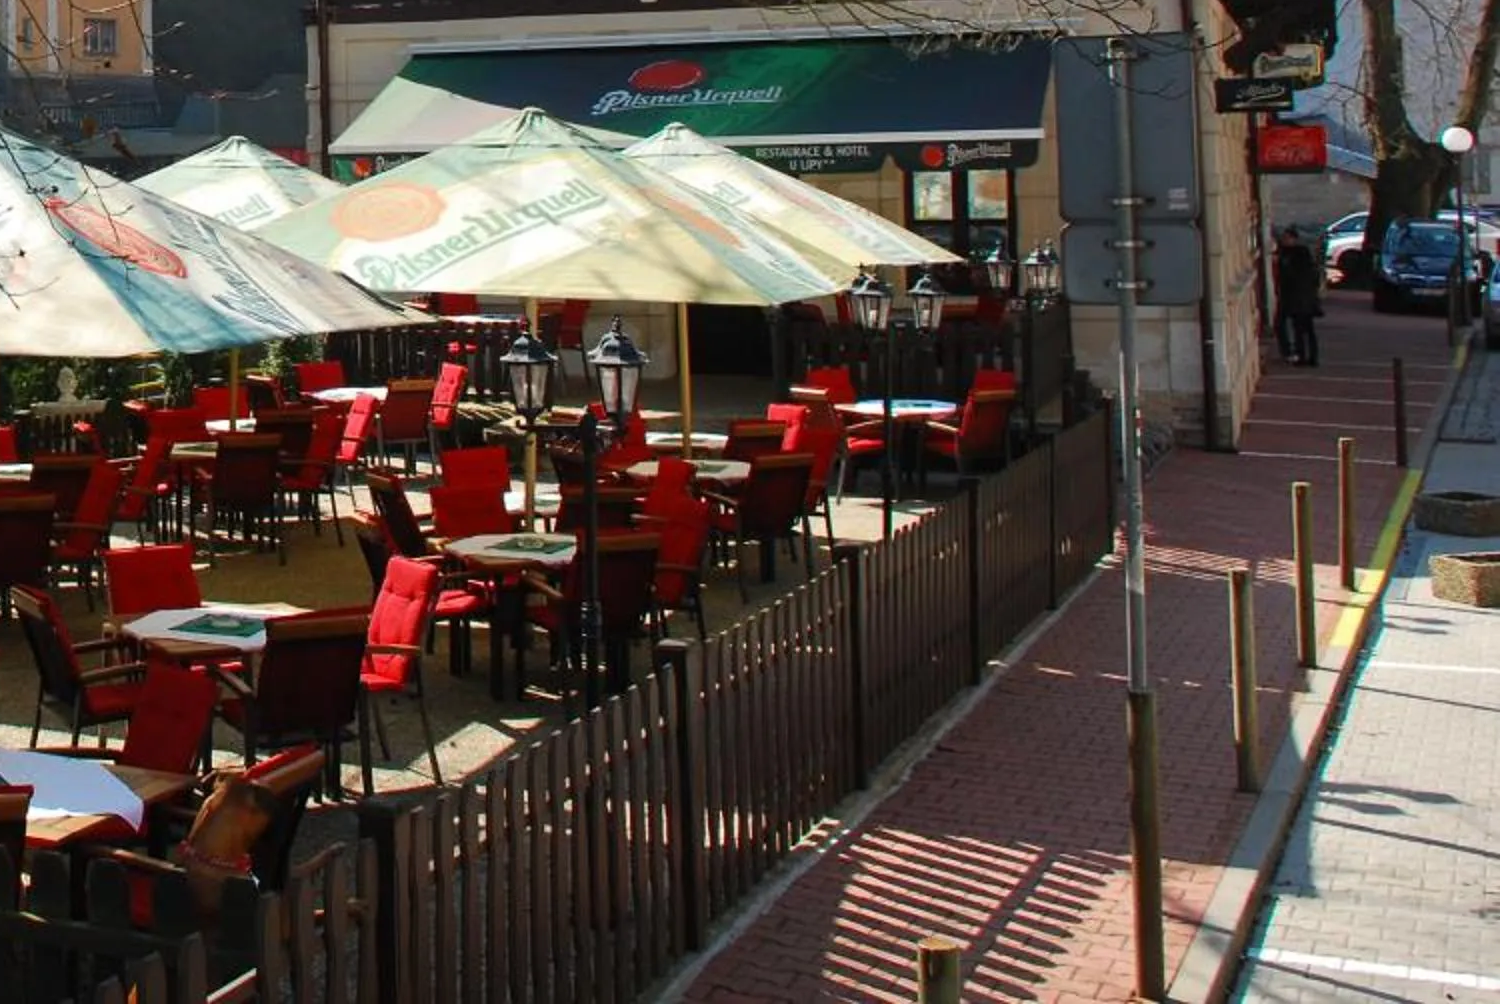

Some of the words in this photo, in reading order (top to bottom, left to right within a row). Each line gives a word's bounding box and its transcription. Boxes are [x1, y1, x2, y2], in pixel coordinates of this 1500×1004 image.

[591, 90, 691, 115] Pilsner
[691, 86, 782, 106] Urquell
[755, 147, 821, 158] RESTAURACE
[823, 147, 833, 157] &
[836, 145, 870, 157] HOTEL
[789, 160, 797, 171] U
[354, 221, 485, 290] Pilsner
[463, 178, 607, 238] Urquell
